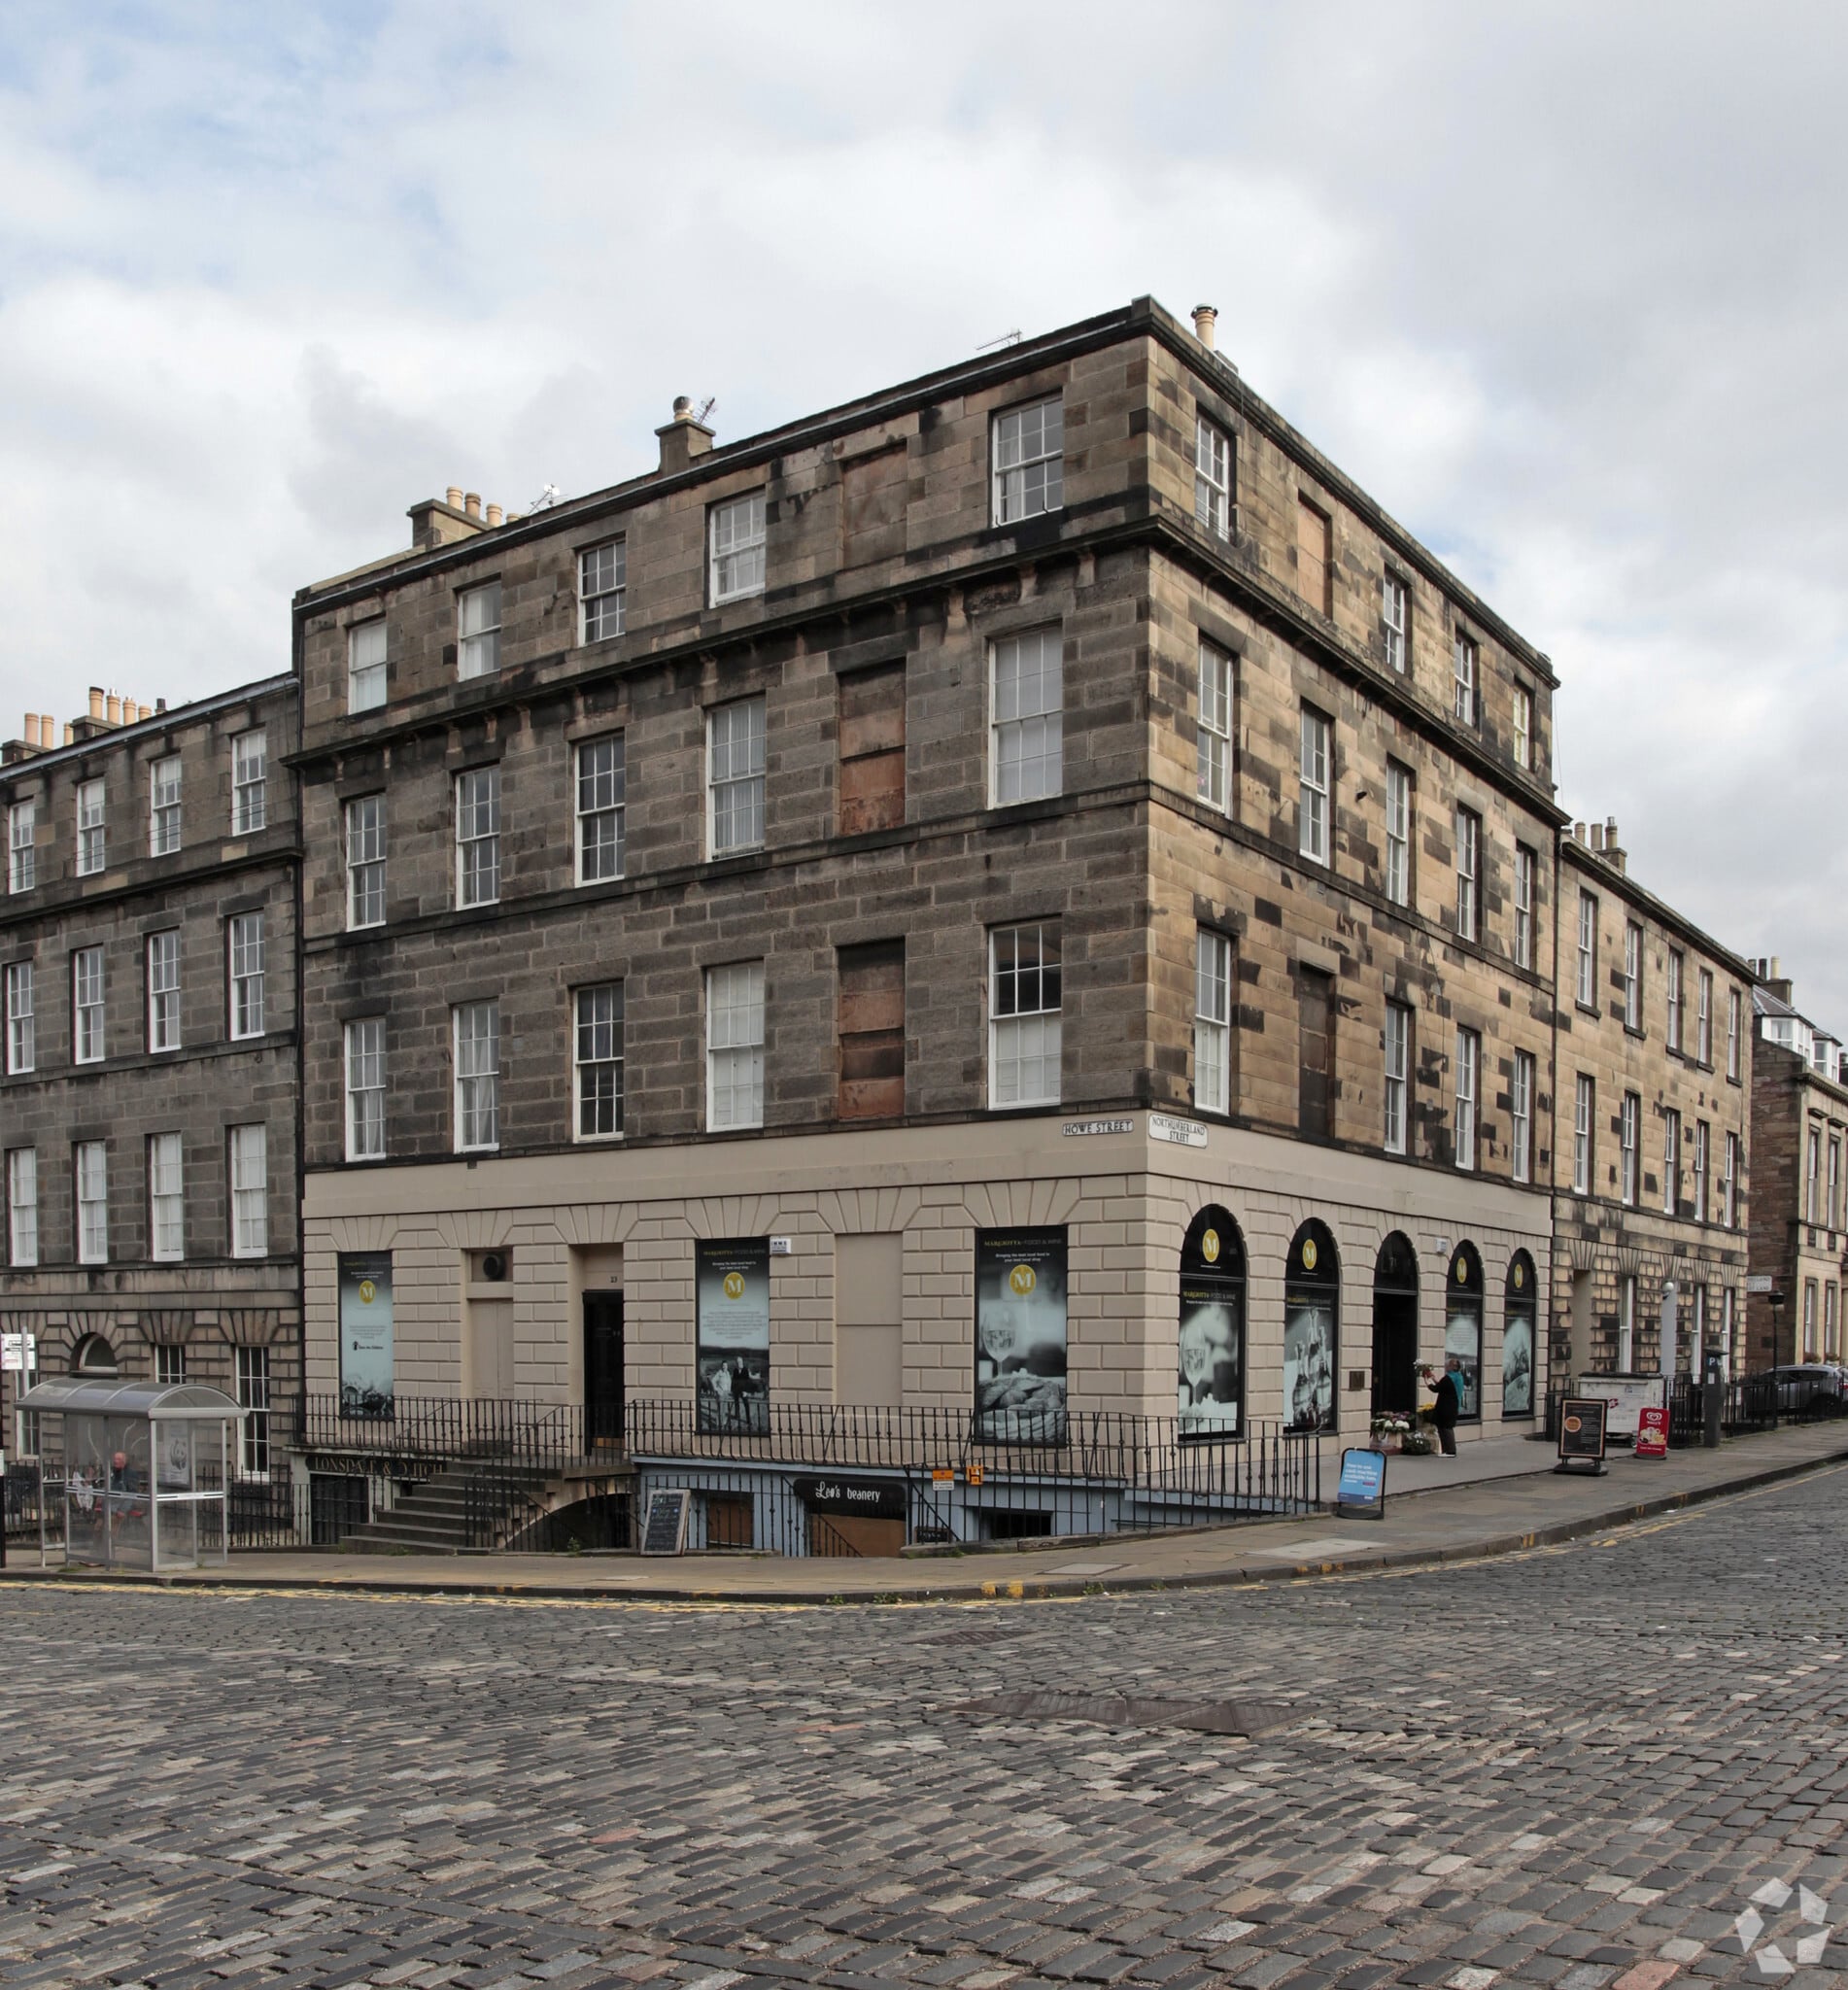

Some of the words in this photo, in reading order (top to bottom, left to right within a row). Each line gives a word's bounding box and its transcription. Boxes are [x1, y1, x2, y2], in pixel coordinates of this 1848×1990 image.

[1065, 1123, 1092, 1134] HOWE
[1096, 1120, 1131, 1133] STREET
[1151, 1116, 1205, 1136] NORTHUMBERLAND
[1169, 1130, 1189, 1144] STREET
[315, 1457, 377, 1474] LONSDAE
[383, 1460, 393, 1476] &
[815, 1481, 841, 1499] Leo's
[846, 1487, 881, 1503] beanery
